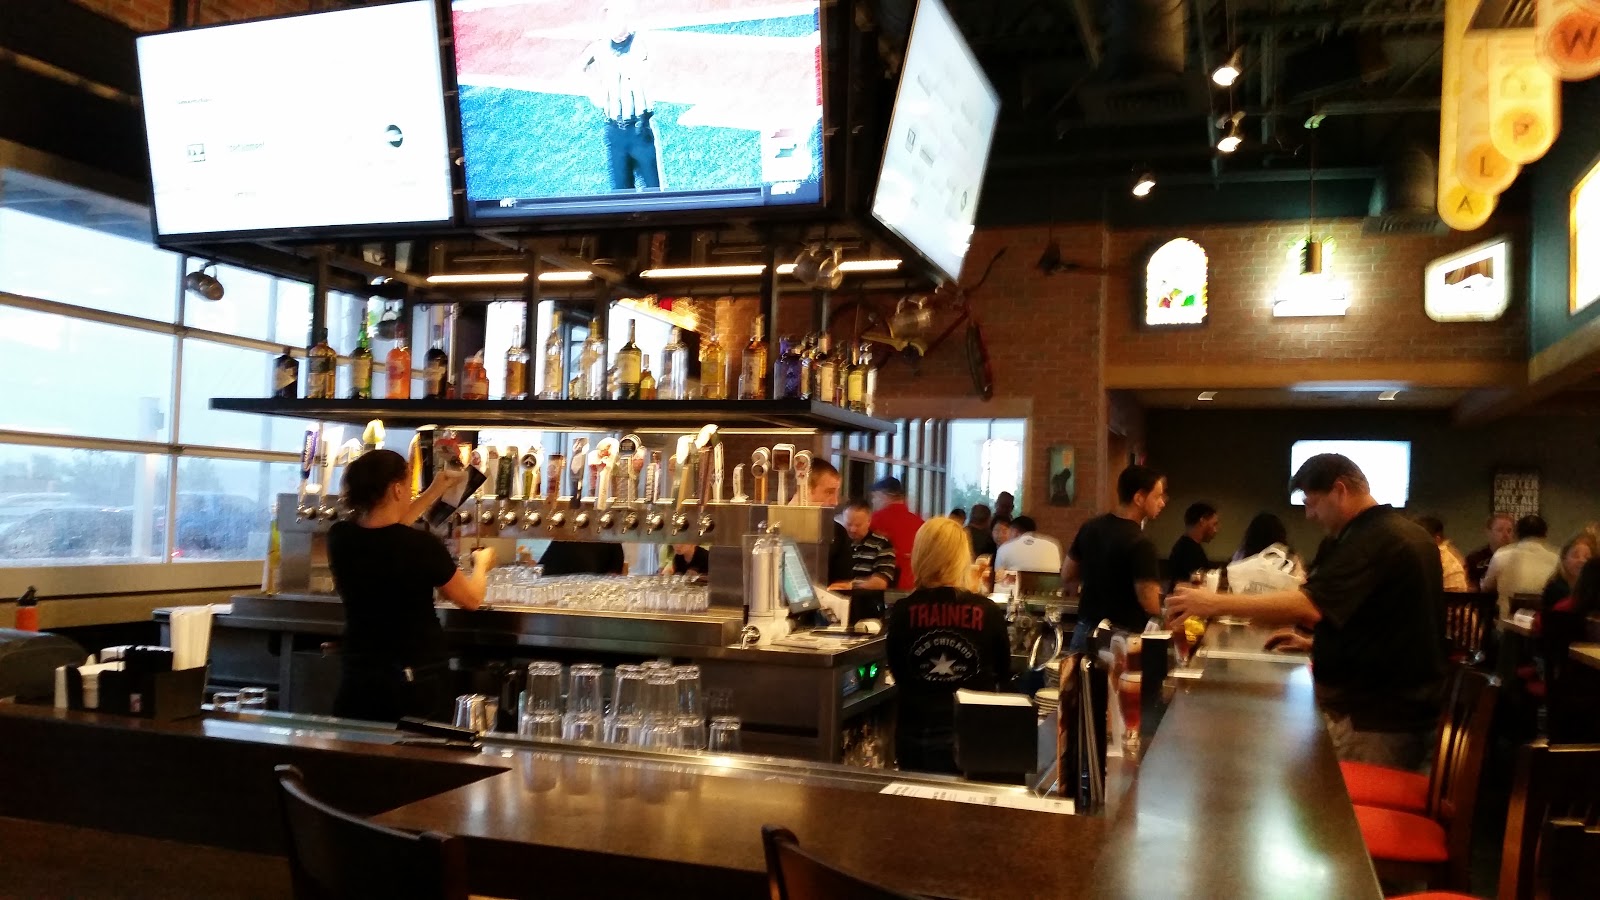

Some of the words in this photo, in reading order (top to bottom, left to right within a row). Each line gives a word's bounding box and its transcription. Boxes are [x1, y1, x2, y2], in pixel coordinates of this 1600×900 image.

[1479, 156, 1493, 178] L
[1455, 195, 1473, 215] A
[908, 602, 984, 631] TRAINER
[914, 641, 931, 657] OLD
[933, 638, 973, 659] CHICAGO
